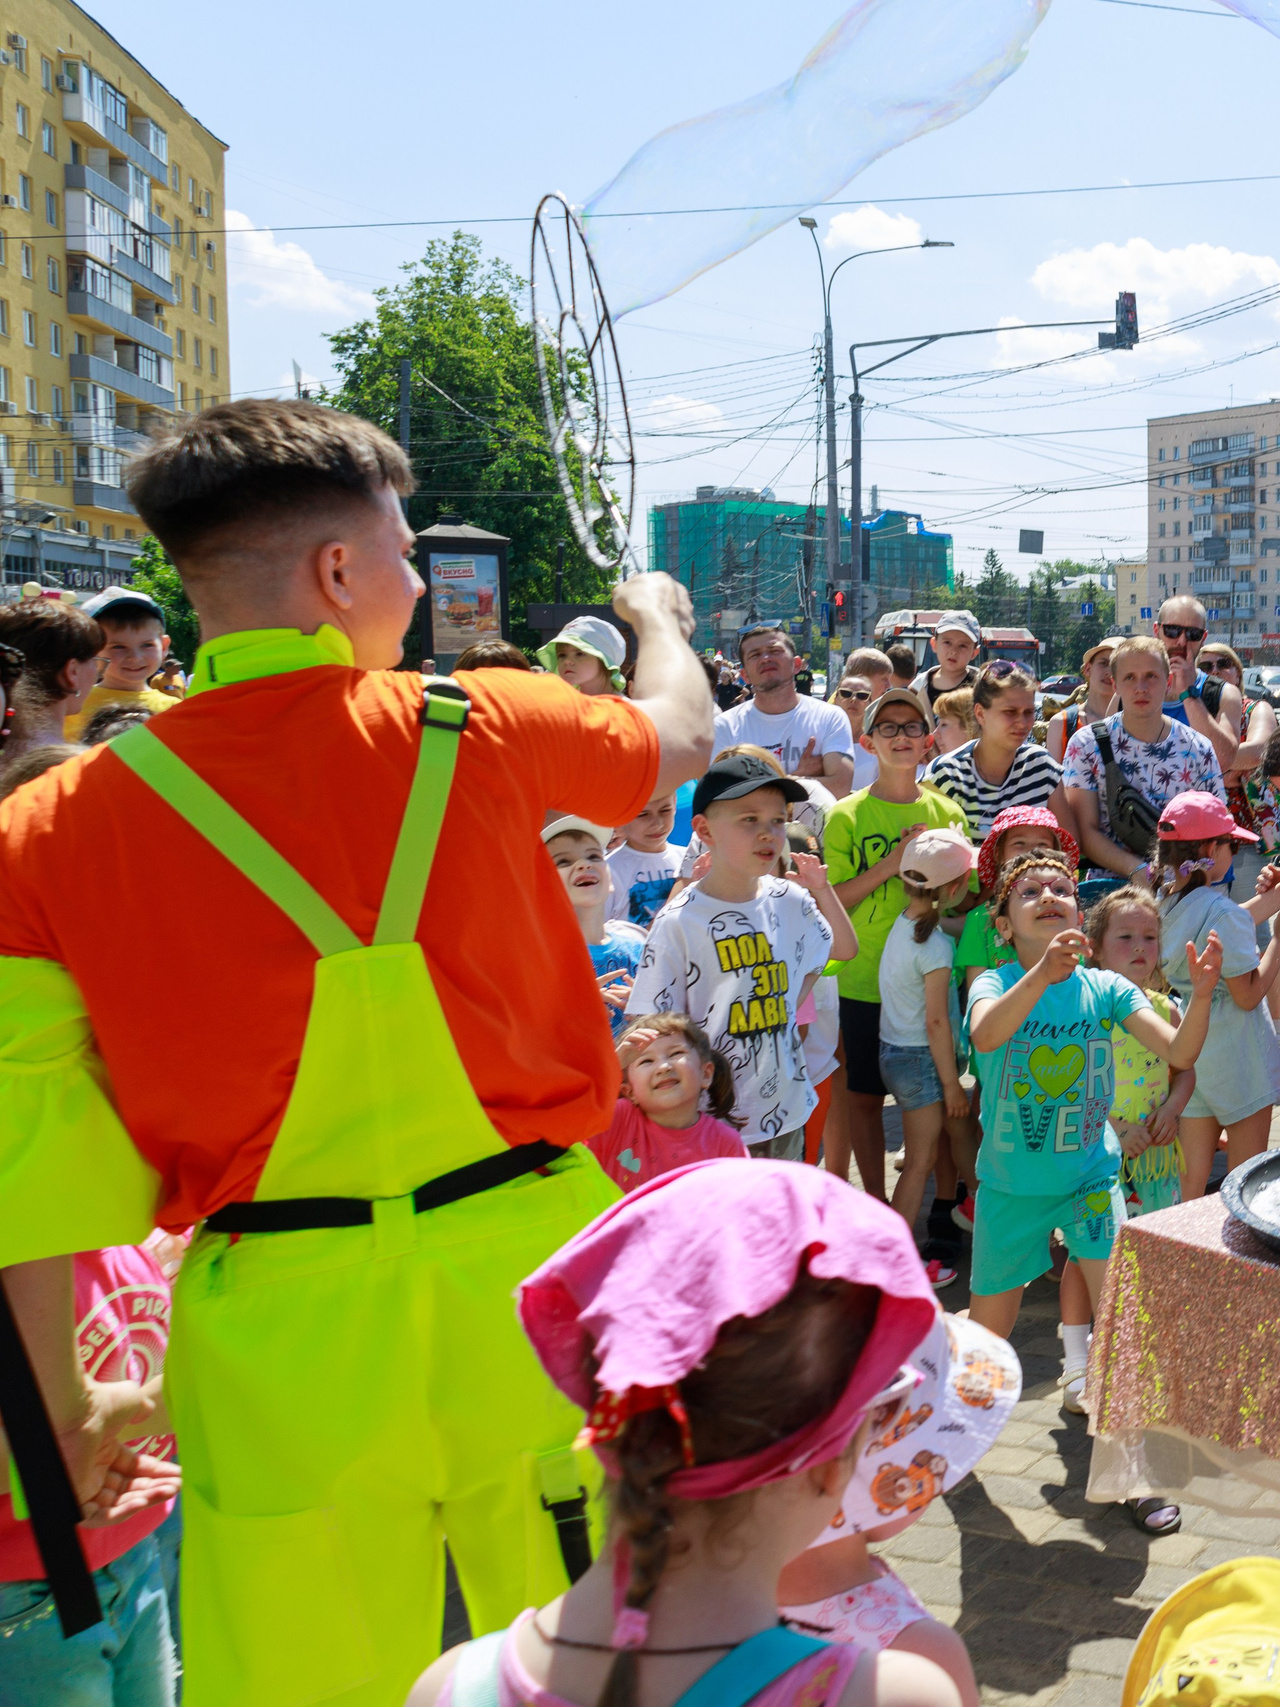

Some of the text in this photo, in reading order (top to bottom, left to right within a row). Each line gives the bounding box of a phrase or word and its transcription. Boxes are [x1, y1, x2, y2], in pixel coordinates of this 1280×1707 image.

[442, 568, 473, 576] ВКУСНО
[714, 931, 773, 973] ПОЛ
[752, 960, 789, 997] ЭТО
[728, 995, 788, 1036] ЛАВА
[1020, 1019, 1098, 1040] never
[993, 1099, 1109, 1153] EVER
